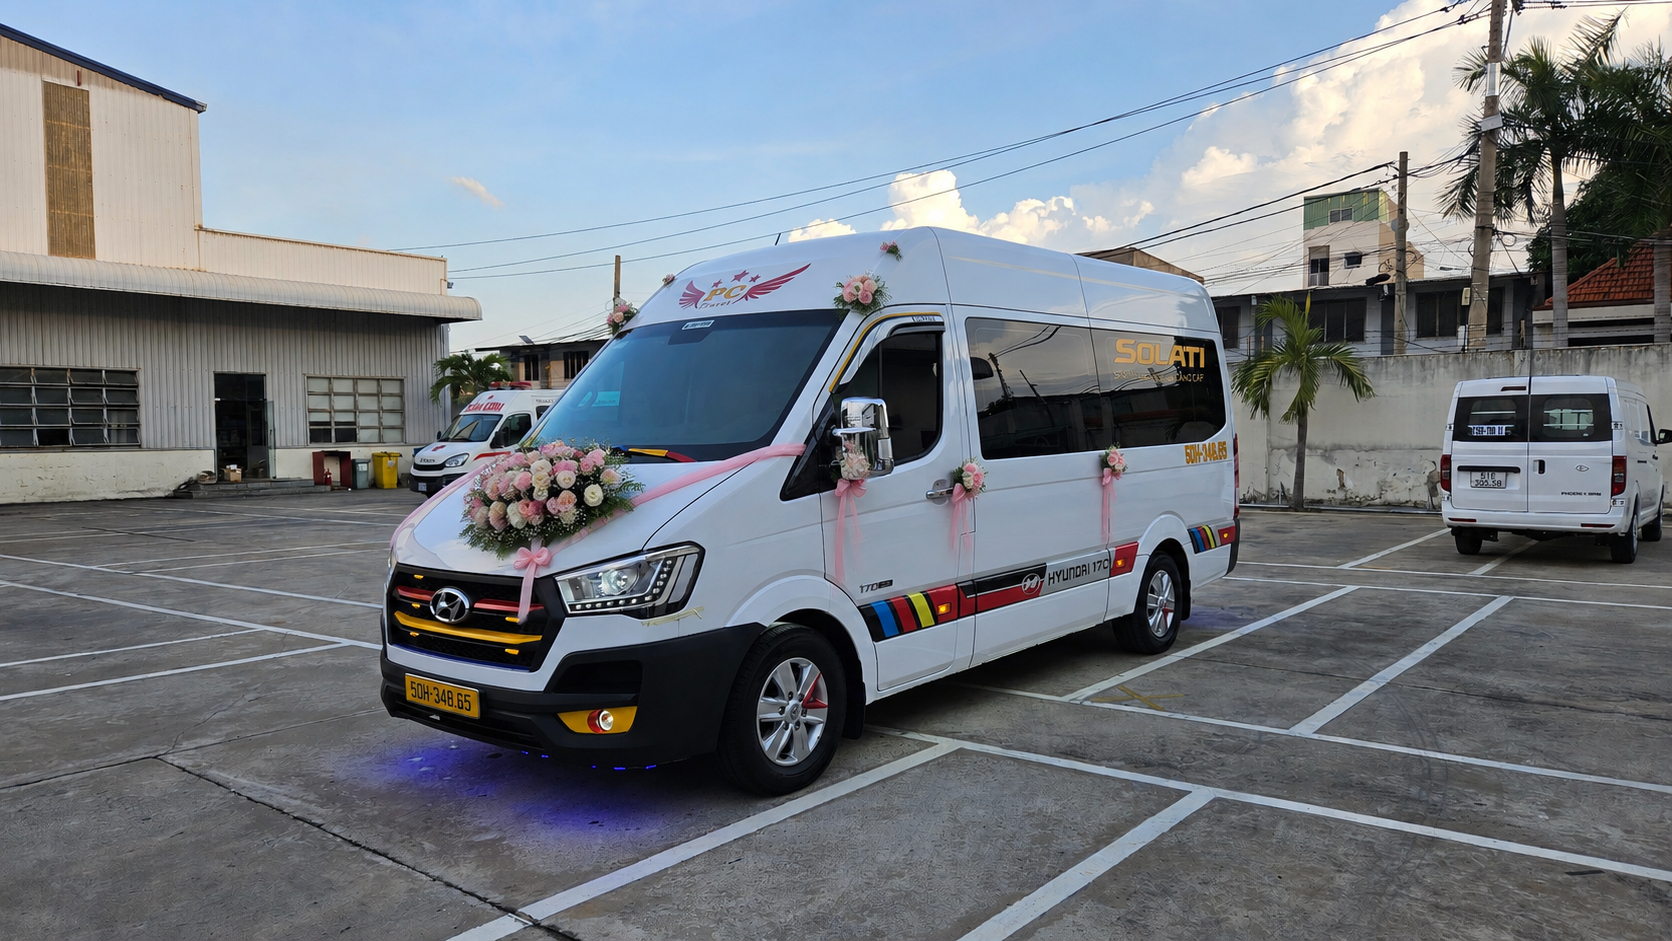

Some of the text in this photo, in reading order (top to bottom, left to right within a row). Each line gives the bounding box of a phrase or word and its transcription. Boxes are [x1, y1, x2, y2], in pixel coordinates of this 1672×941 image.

[704, 284, 747, 301] PC
[1114, 338, 1205, 368] SOLATI
[1047, 563, 1090, 586] HYUNDAI
[410, 681, 471, 711] 50H-348.65
